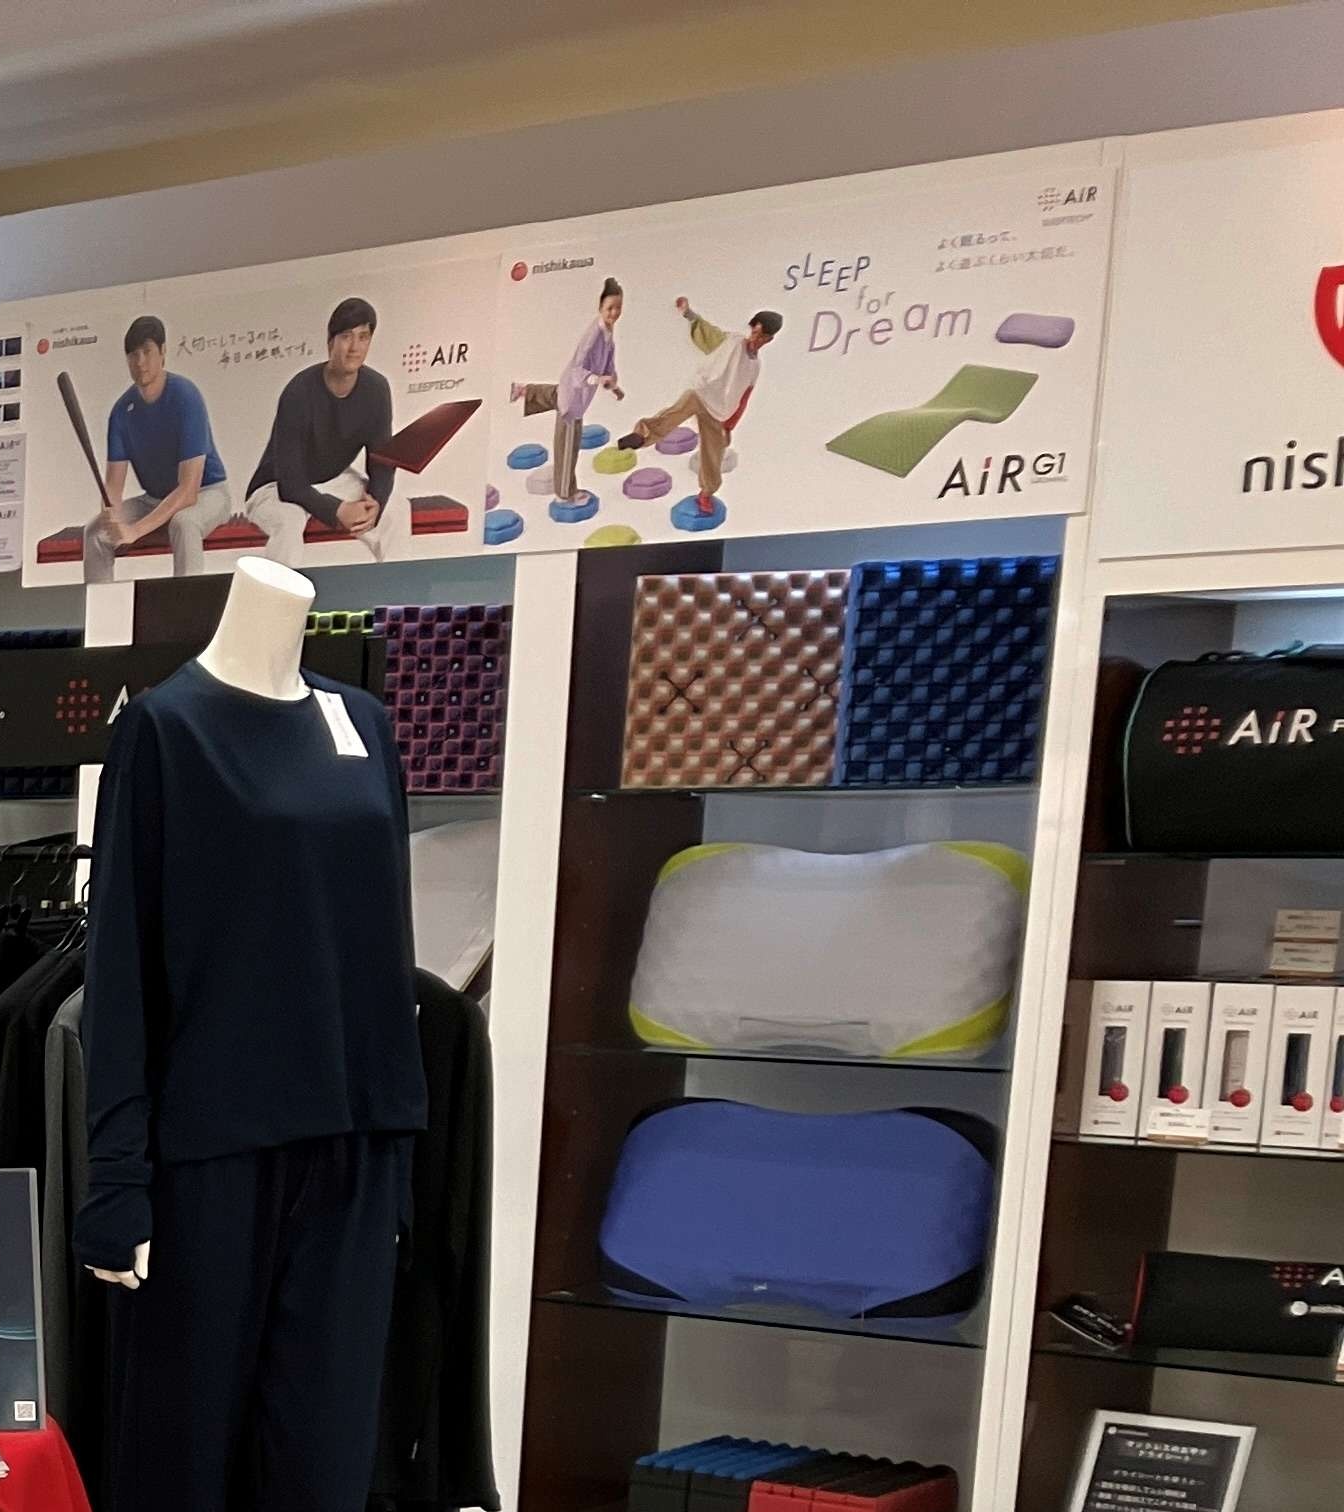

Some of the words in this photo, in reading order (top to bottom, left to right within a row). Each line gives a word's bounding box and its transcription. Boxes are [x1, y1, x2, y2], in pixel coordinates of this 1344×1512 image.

[783, 253, 871, 292] SLEEP
[856, 285, 896, 314] for
[808, 303, 972, 355] Dream
[1032, 452, 1066, 475] G1
